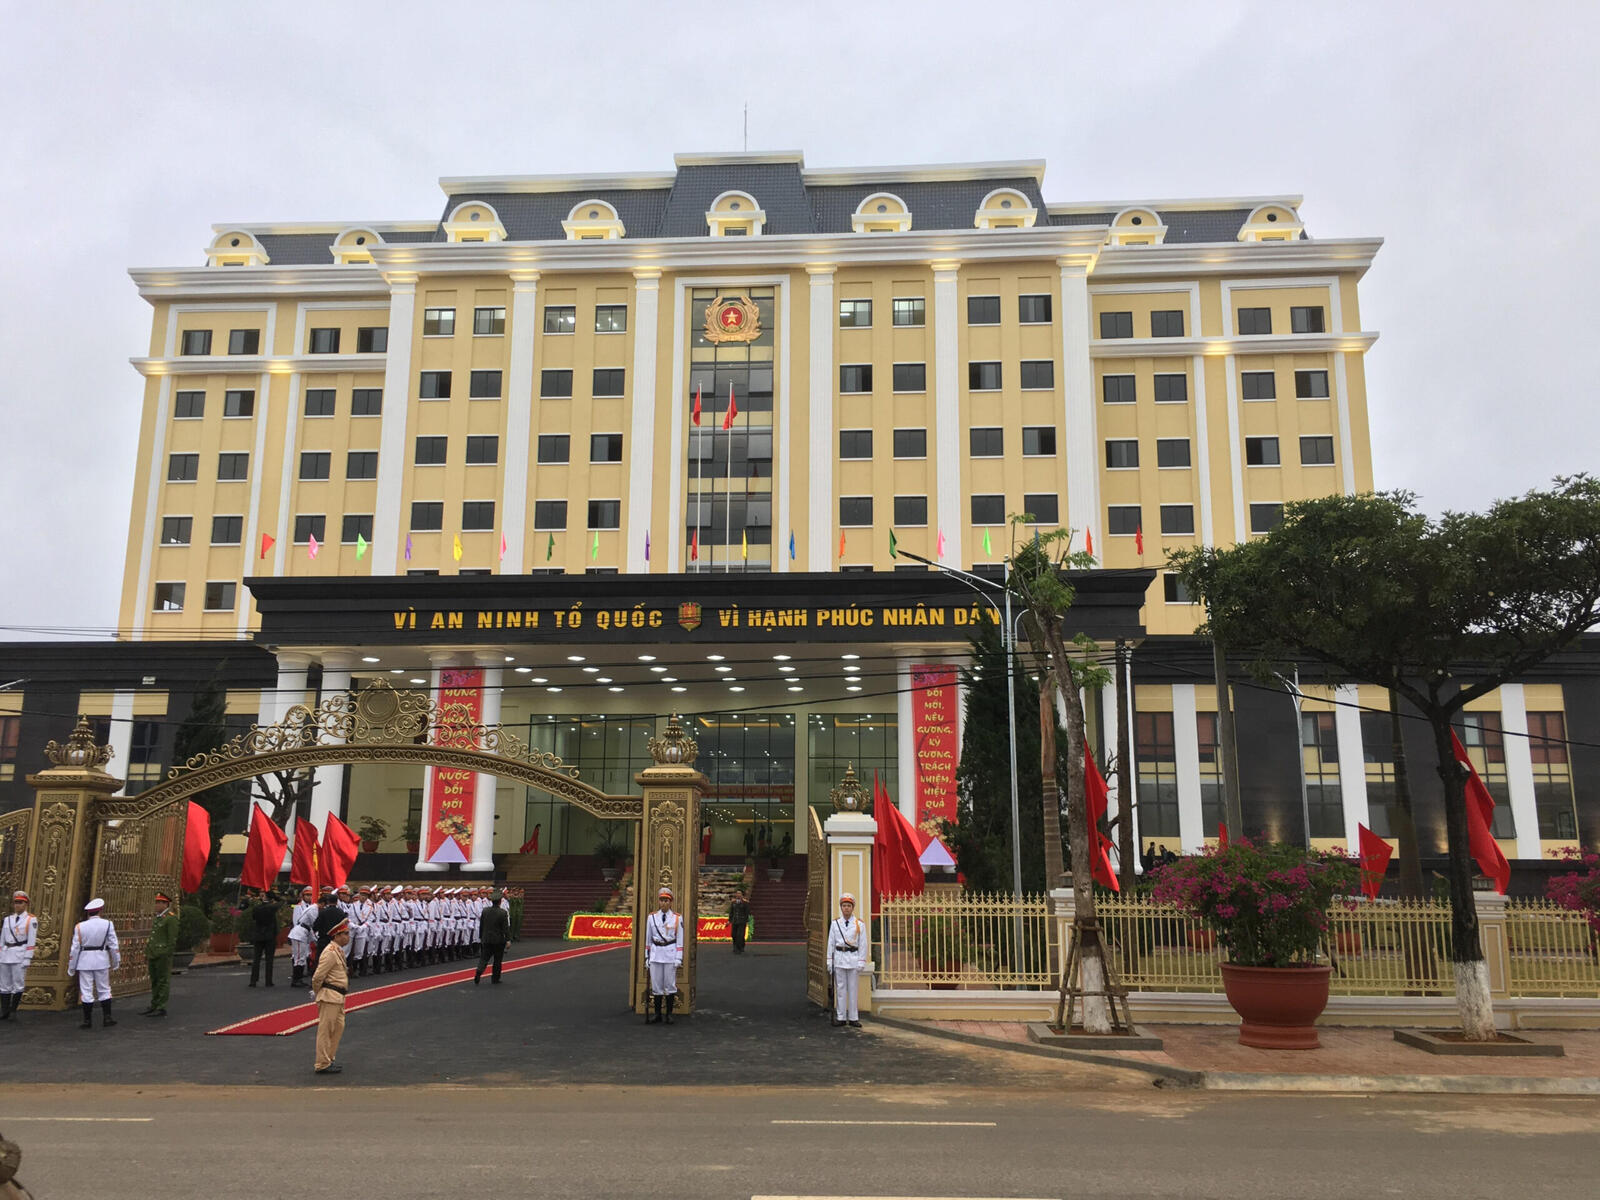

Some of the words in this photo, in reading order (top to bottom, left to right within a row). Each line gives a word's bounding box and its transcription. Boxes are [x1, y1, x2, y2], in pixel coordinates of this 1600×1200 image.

[394, 606, 417, 629] VÌ
[430, 611, 464, 629] AN
[477, 611, 539, 629] NINH
[554, 601, 582, 628] TỔ
[596, 602, 663, 630] QUỐC
[719, 603, 739, 627] VÌ
[748, 609, 807, 631] HẠNH
[817, 603, 873, 626] PHÚC
[883, 603, 945, 625] NHÂN
[924, 785, 946, 798] HIỆU
[925, 797, 945, 809] QUẢ
